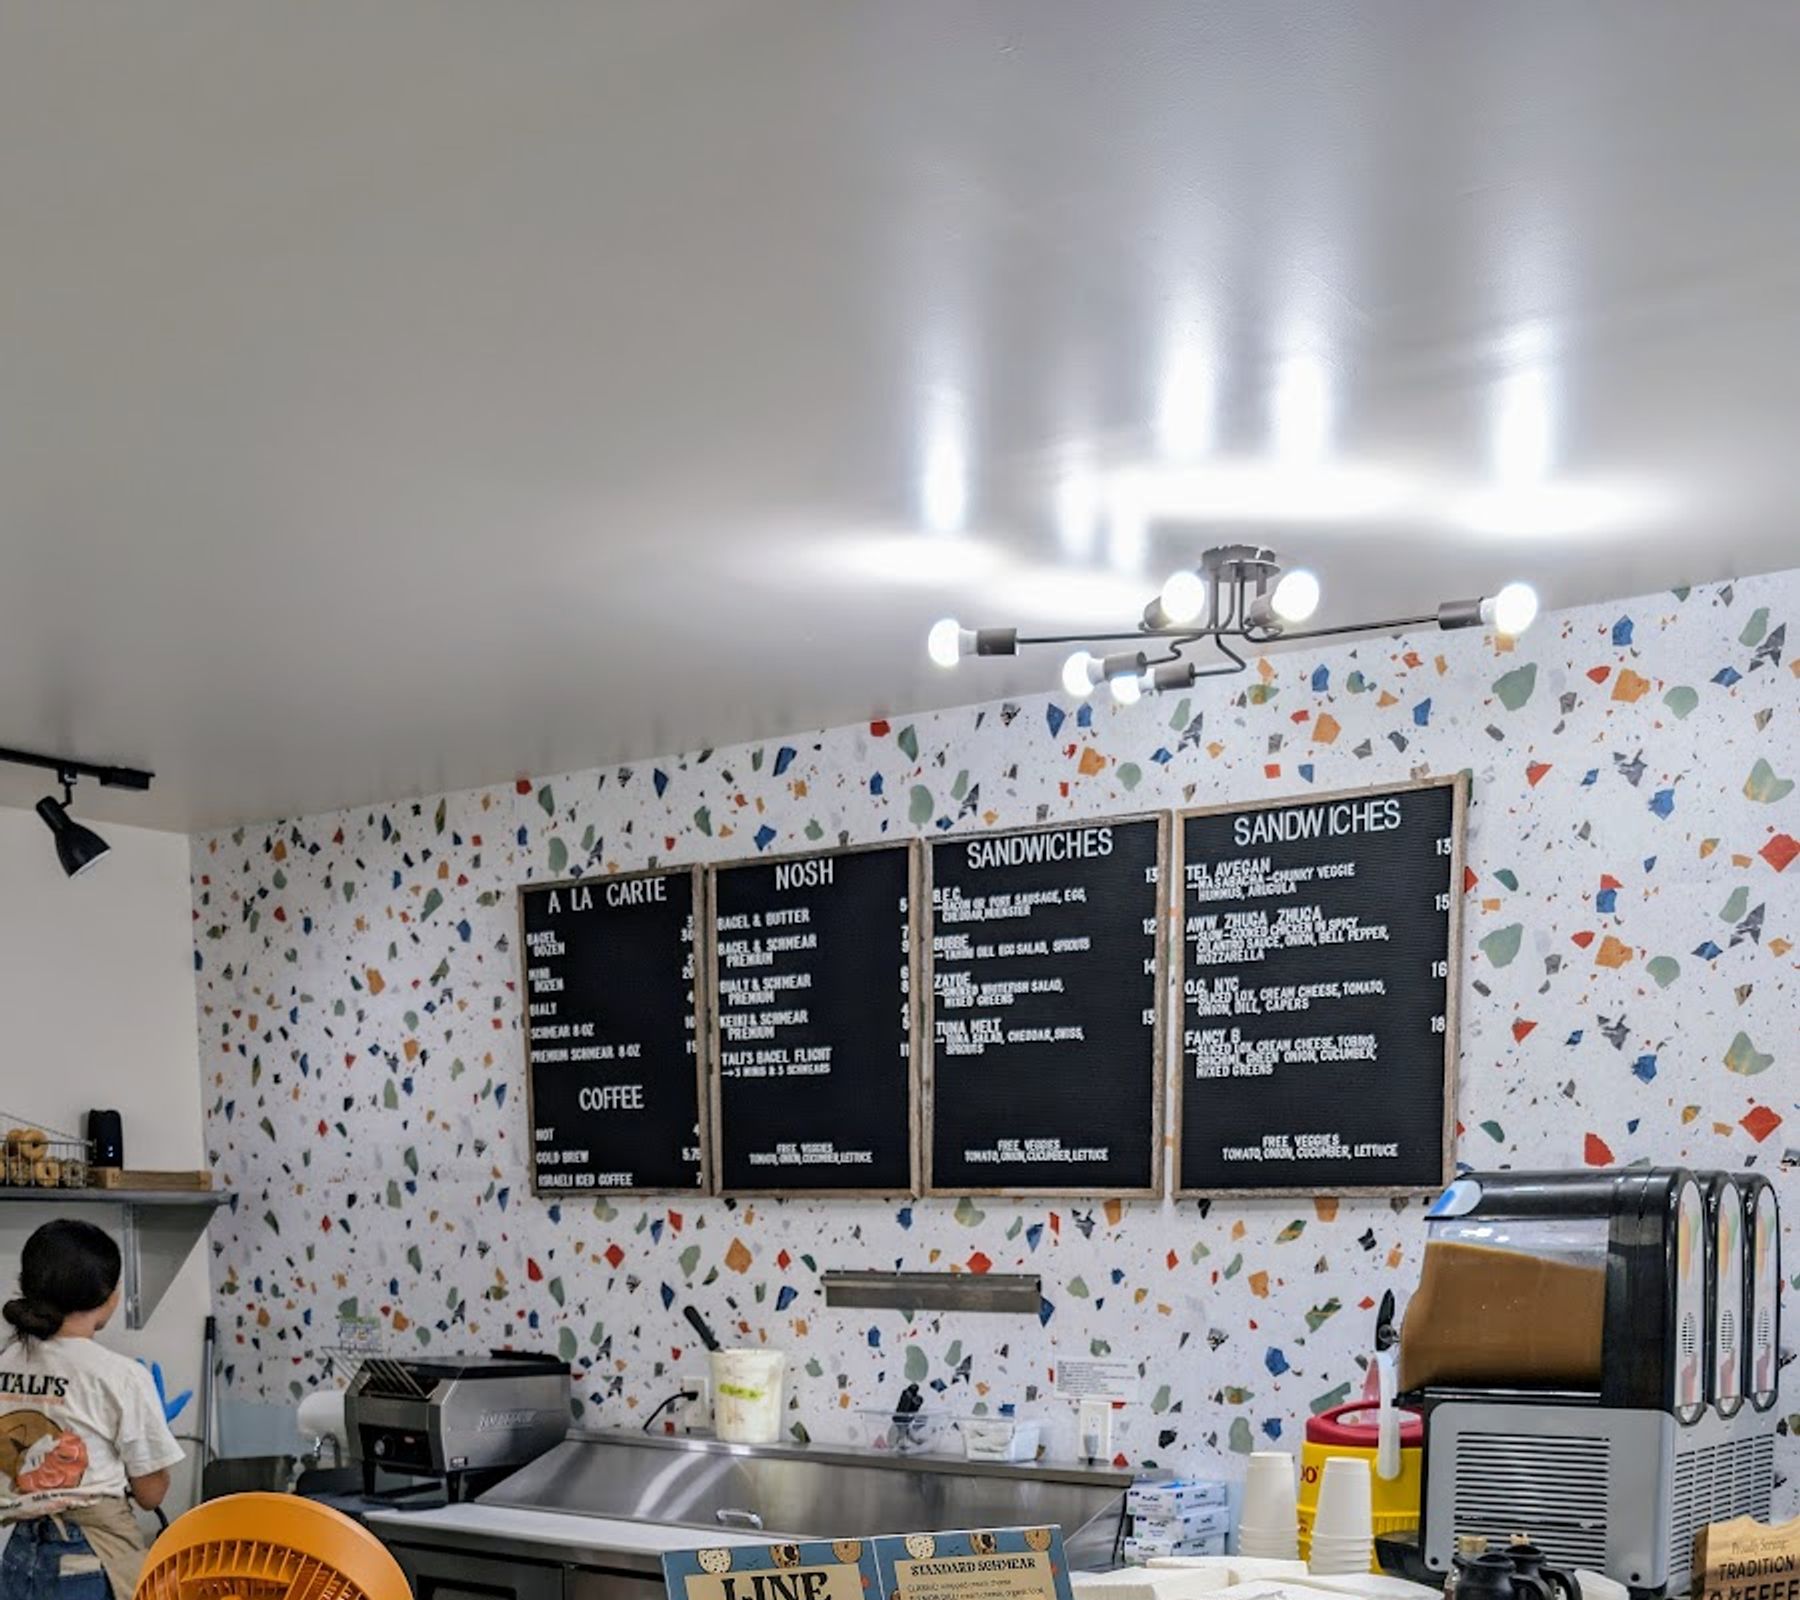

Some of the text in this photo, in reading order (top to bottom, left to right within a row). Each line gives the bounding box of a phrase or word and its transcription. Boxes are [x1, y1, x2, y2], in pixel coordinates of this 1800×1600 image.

[967, 828, 1113, 869] SANDWICHES
[1436, 838, 1451, 855] 13
[775, 858, 833, 891] NOSH
[1145, 866, 1158, 883] 13
[1184, 857, 1271, 881] TEL AVEGAN
[1316, 862, 1355, 879] VEGGIE
[548, 876, 667, 914] A LA CARTE
[1248, 879, 1297, 898] ARUGULA
[899, 897, 907, 913] 5
[1435, 894, 1450, 912] 15
[717, 907, 810, 931] BAGEL & BUTTER
[1142, 918, 1157, 935] 12
[1186, 914, 1219, 934] AWW
[1328, 915, 1360, 931] SPICY
[718, 940, 751, 957] BAGEL
[765, 933, 817, 952] SCHMEAR
[1246, 935, 1284, 950] SAUCE,
[1319, 928, 1345, 944] BELL
[1348, 924, 1390, 942] PEPPER,
[1196, 949, 1265, 965] MOZZARELLA
[1431, 961, 1447, 979] 16
[762, 973, 811, 990] SCHMEAR
[1031, 978, 1065, 994] SALAD,
[1214, 976, 1239, 993] NYC
[1260, 984, 1297, 1001] CREAM
[1298, 981, 1342, 999] CHEESE,
[1342, 978, 1386, 996] TOMATO,
[1234, 999, 1262, 1015] DILL,
[1265, 997, 1309, 1012] CAPERS
[760, 1009, 808, 1026] SCHMEAR
[1142, 1009, 1155, 1025] 15
[1430, 1016, 1445, 1033] 18
[1184, 1029, 1226, 1047] FANCY
[756, 1050, 790, 1065] BAGEL
[794, 1046, 832, 1063] FLIGHT
[1245, 1050, 1280, 1065] GREEN
[1232, 1062, 1274, 1077] GREENS
[578, 1085, 644, 1111] COFFEE
[535, 1128, 555, 1141] HOT
[1262, 1133, 1340, 1149] FREE VEGGIES
[536, 1151, 560, 1165] COLD
[1354, 1143, 1398, 1158] LETTUCE
[598, 1171, 633, 1187] COFFEE
[910, 1557, 1036, 1577] STANDARD SCHMEAR
[1719, 1554, 1795, 1582] TRADITION
